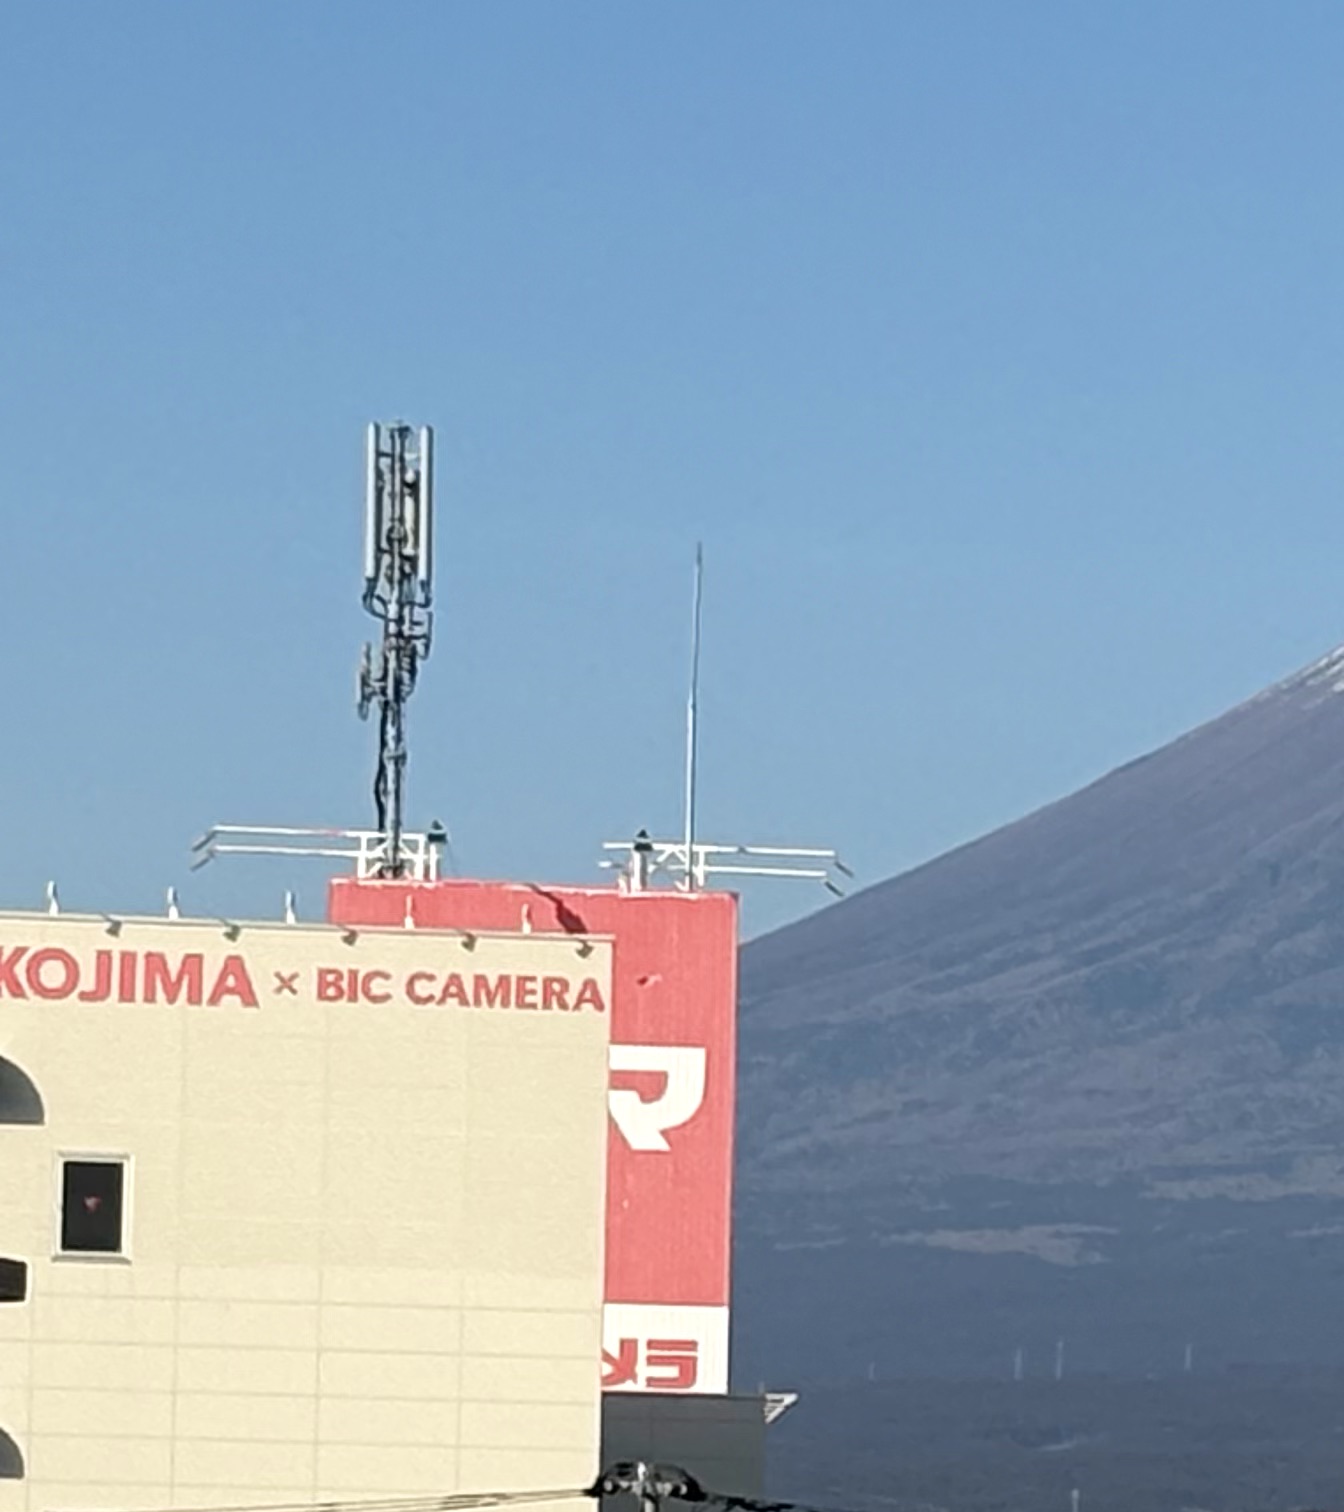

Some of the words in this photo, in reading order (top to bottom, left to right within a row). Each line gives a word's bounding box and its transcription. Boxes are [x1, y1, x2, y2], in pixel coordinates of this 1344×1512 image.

[0, 946, 259, 1008] KOJIMA
[316, 966, 393, 1004] BIC
[405, 971, 605, 1013] CAMERA
